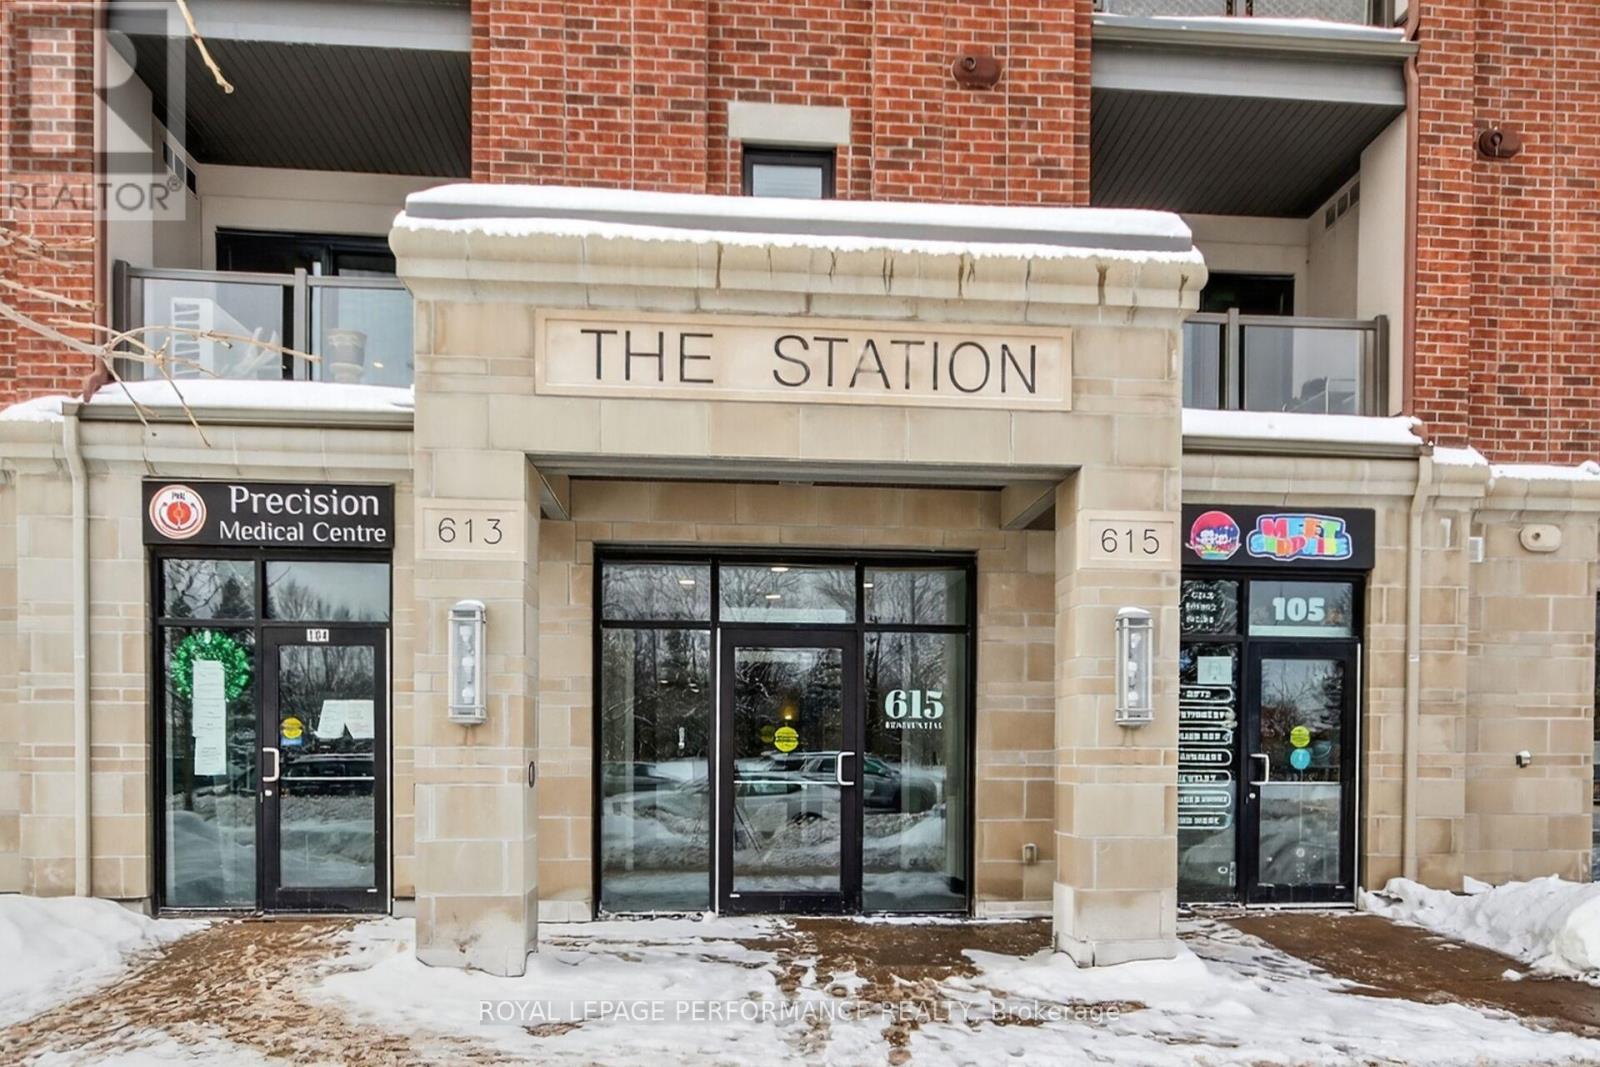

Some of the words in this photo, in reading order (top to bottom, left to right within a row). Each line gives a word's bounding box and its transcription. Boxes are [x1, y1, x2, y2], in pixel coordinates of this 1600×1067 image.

[580, 328, 715, 385] THE
[772, 334, 1038, 396] STATION
[228, 484, 381, 517] Precision
[219, 521, 304, 542] Medical
[312, 522, 387, 544] Centre
[437, 517, 504, 545] 613
[1100, 526, 1161, 555] 615
[1260, 517, 1342, 539] MEET
[1272, 597, 1326, 622] 105
[884, 689, 945, 719] 615
